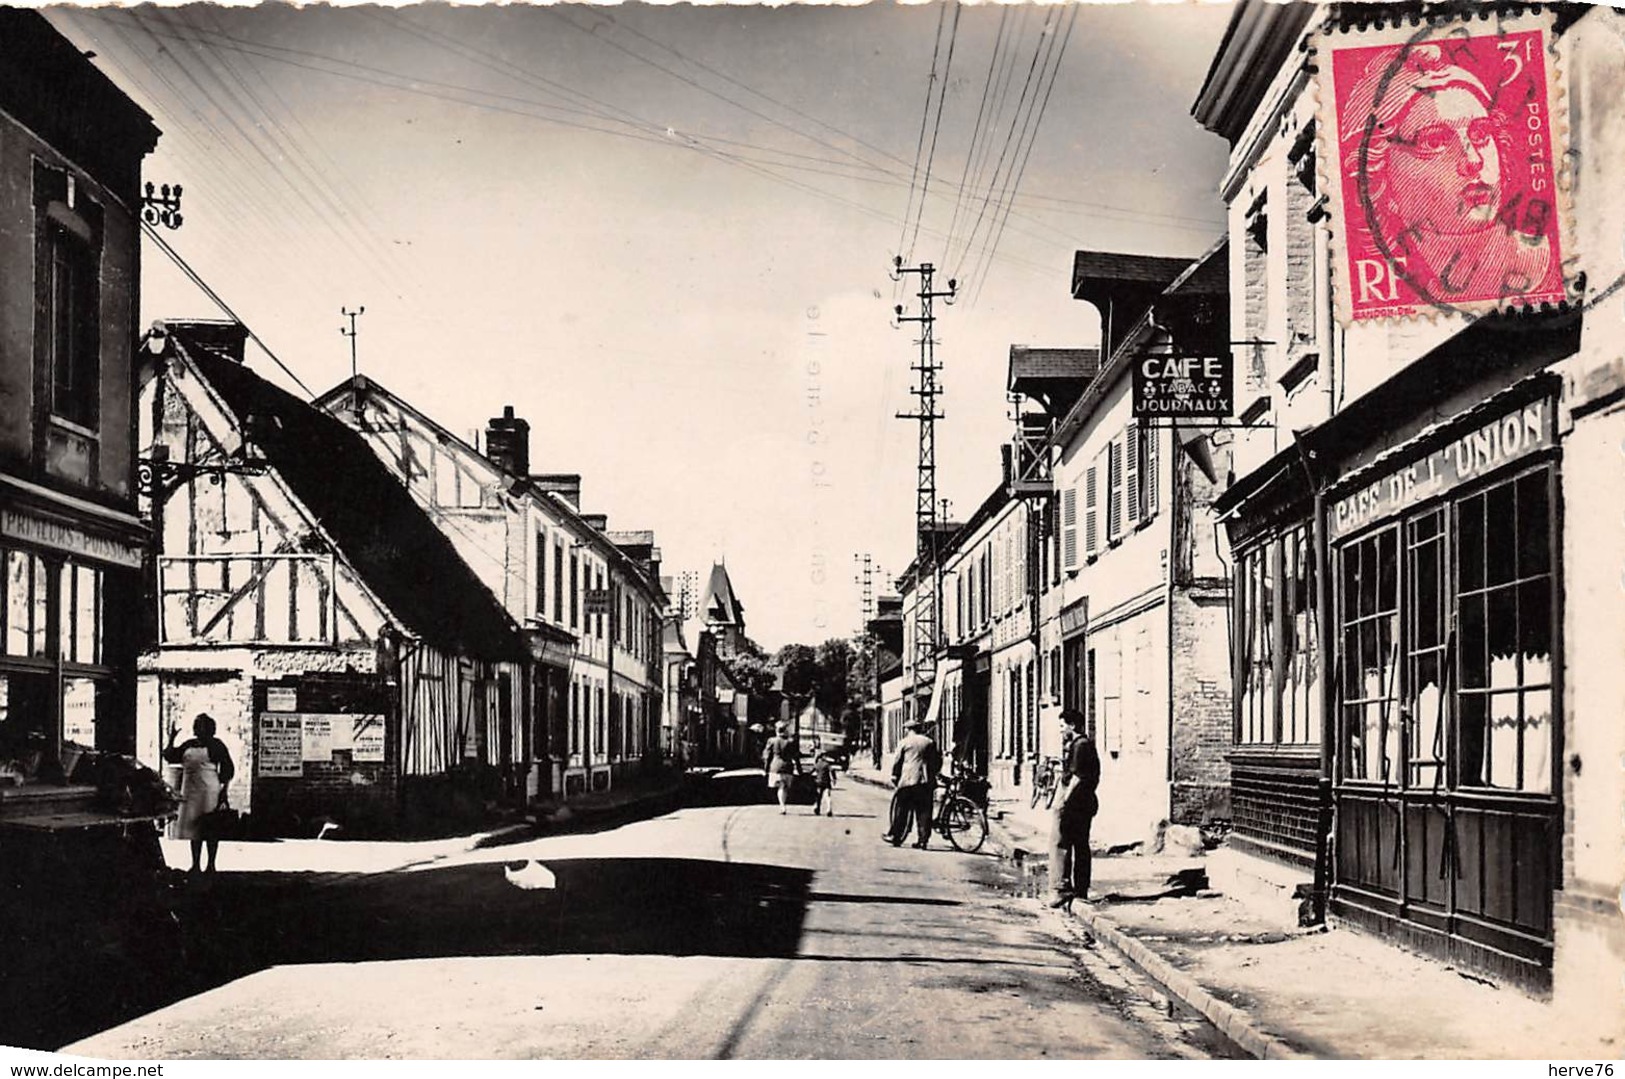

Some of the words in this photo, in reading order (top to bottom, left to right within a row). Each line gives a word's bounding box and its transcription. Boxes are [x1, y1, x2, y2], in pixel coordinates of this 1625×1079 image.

[1526, 102, 1547, 193] POSTES
[1356, 256, 1409, 304] RF
[1141, 357, 1223, 379] CAFE
[1135, 398, 1229, 412] JOURNAUX
[1159, 382, 1206, 394] TABAC
[1389, 466, 1418, 506] DE
[6, 512, 74, 547] PRIMEURS
